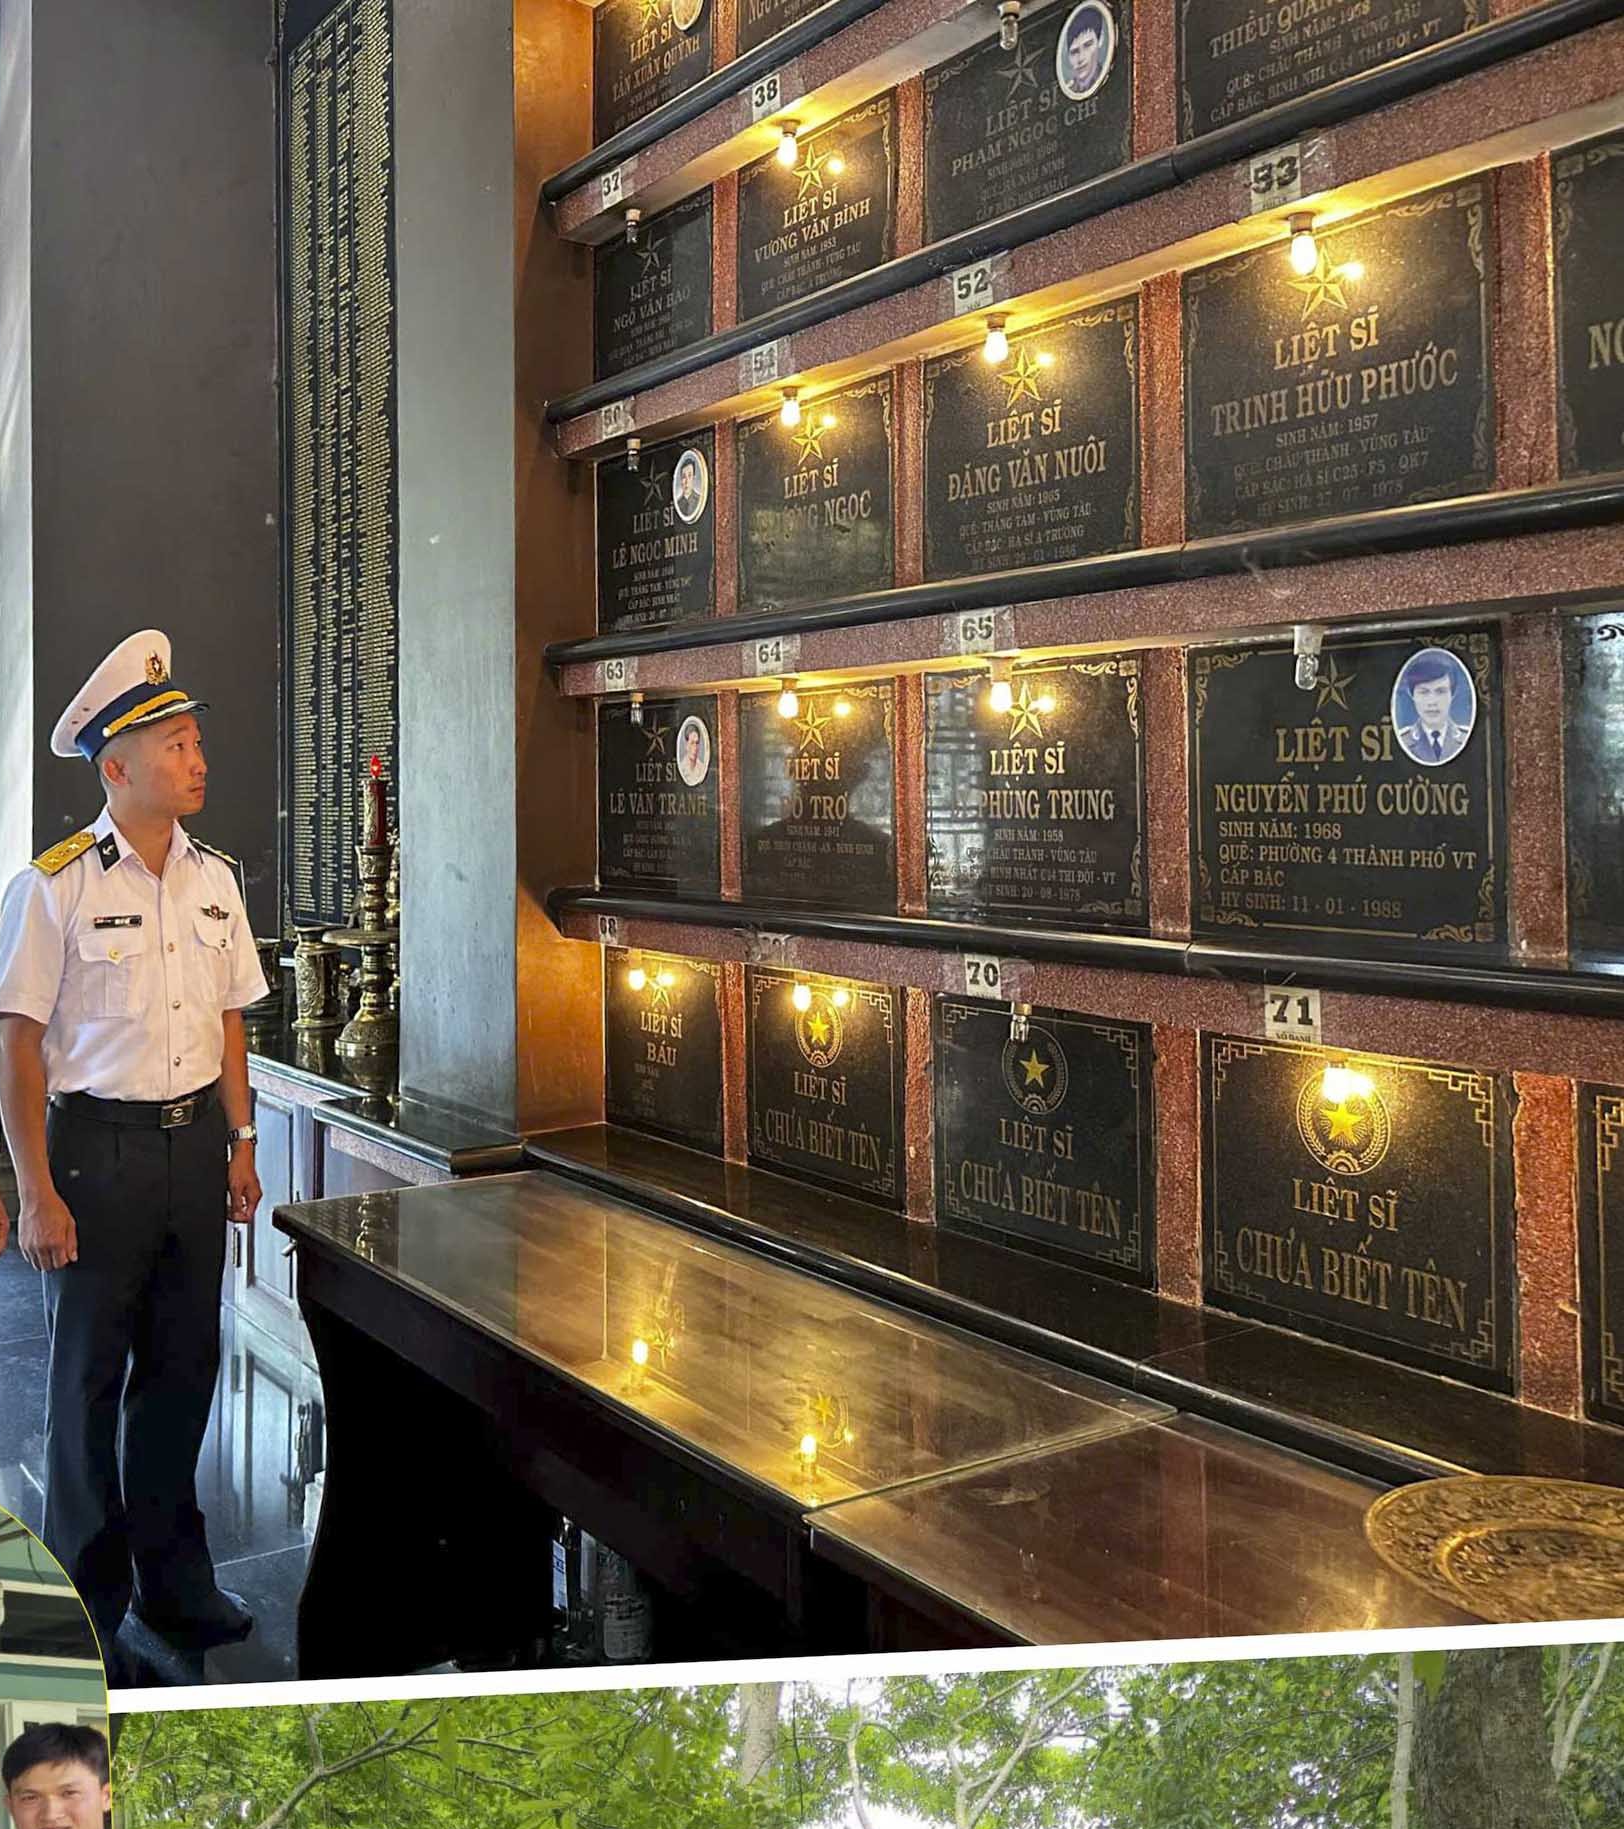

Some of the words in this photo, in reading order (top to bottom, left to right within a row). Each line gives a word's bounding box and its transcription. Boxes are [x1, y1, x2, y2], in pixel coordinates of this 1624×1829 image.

[754, 79, 778, 107] 38
[602, 174, 620, 196] 37
[1252, 156, 1299, 193] 53
[957, 268, 992, 300] 52
[1273, 321, 1340, 376] LIỆT
[1350, 304, 1379, 351] SĨ
[1211, 388, 1289, 440] TRỊNH
[1361, 340, 1458, 406] PHƯỚC
[986, 409, 1034, 449] LIỆT
[948, 462, 1002, 505] ĐẶNG
[1008, 449, 1049, 489] VĂN
[1054, 434, 1106, 480] NUÔI
[664, 531, 698, 557] MINH
[962, 615, 994, 642] 65
[606, 661, 623, 681] 63
[758, 641, 783, 664] 64
[990, 742, 1038, 781] LIỆT
[1044, 741, 1065, 775] SĨ
[1276, 717, 1350, 772] LIỆT
[1361, 715, 1394, 763] SĨ
[785, 752, 822, 786] LIỆT
[978, 781, 1041, 820] PHÙNG
[1047, 788, 1115, 821] TRUNG
[1215, 771, 1311, 815] NGUYỄN
[1318, 772, 1368, 814] PHÚ
[1377, 774, 1470, 817] CƯỜNG
[1219, 821, 1254, 838] SINH
[1304, 822, 1342, 841] 1968
[1259, 841, 1323, 865] PHƯỜNG
[1344, 841, 1406, 868] THÀNH
[1410, 843, 1446, 870] PHỐ
[1452, 850, 1477, 870] VT
[966, 961, 999, 987] 70
[1270, 993, 1314, 1026] 71
[794, 1068, 828, 1104] LIỆT
[765, 1107, 805, 1150] CHƯA
[808, 1109, 844, 1160] BIẾT
[848, 1122, 881, 1173] TÊN
[999, 1115, 1047, 1157] LIỆT
[1052, 1124, 1074, 1161] SĨ
[960, 1158, 1016, 1212] CHƯA
[1021, 1166, 1071, 1226] BIẾT
[1076, 1180, 1121, 1240] TÊN
[1292, 1176, 1361, 1228] LIỆT
[1368, 1189, 1400, 1233] SĨ
[1237, 1226, 1314, 1292] CHƯA
[1321, 1233, 1393, 1312] BIẾT
[1401, 1257, 1468, 1333] TÊN
